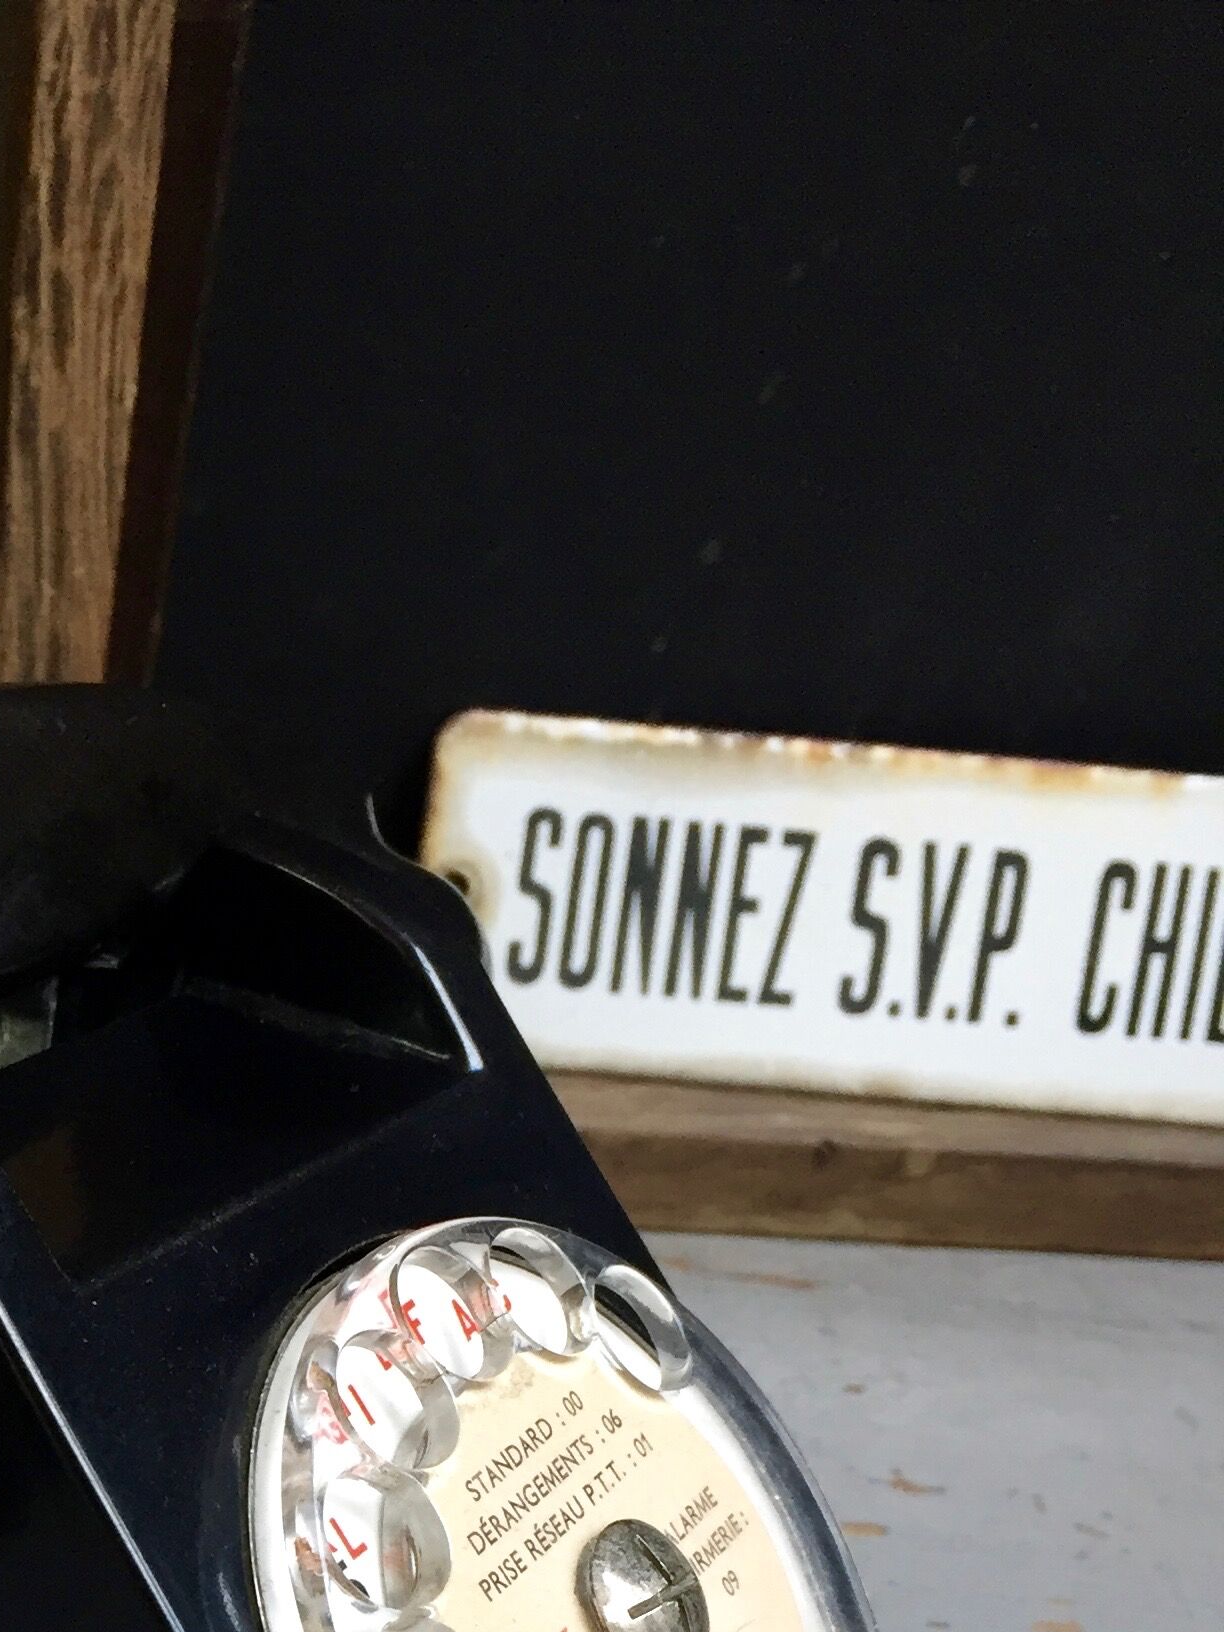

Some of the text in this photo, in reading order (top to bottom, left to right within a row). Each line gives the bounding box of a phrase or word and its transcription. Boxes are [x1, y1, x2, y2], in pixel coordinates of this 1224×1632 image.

[507, 806, 818, 1008] SONNEZ
[838, 837, 1032, 1028] S.V.P.
[465, 1417, 553, 1502] STANDARD
[562, 1390, 584, 1416] 00
[466, 1434, 594, 1556] DÉRANGEMENTS
[601, 1408, 623, 1434] 06
[478, 1550, 528, 1602] PRISE
[524, 1495, 586, 1561] RÉSEAU
[582, 1460, 627, 1506] P.T.T.
[633, 1432, 654, 1458] 01
[688, 1513, 743, 1577] IRMERIE
[721, 1570, 740, 1596] 09
